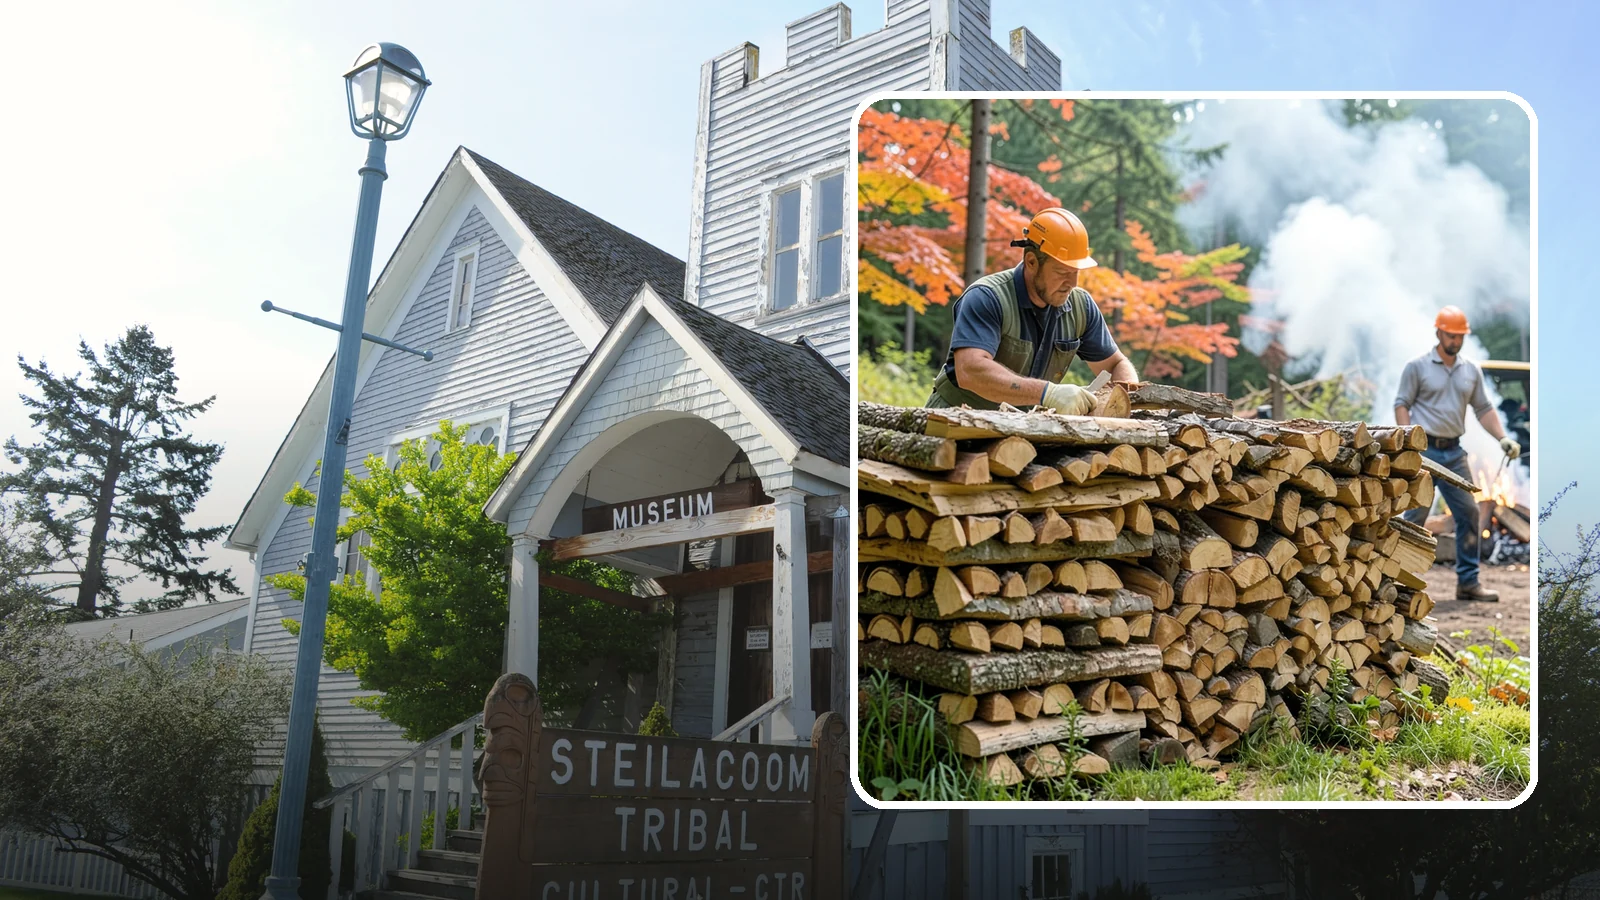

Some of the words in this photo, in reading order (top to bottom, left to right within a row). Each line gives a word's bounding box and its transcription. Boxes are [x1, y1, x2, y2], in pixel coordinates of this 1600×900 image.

[613, 491, 713, 531] MUSEUM
[550, 738, 810, 792] STEILACOOM
[614, 806, 757, 851] TRIBAL
